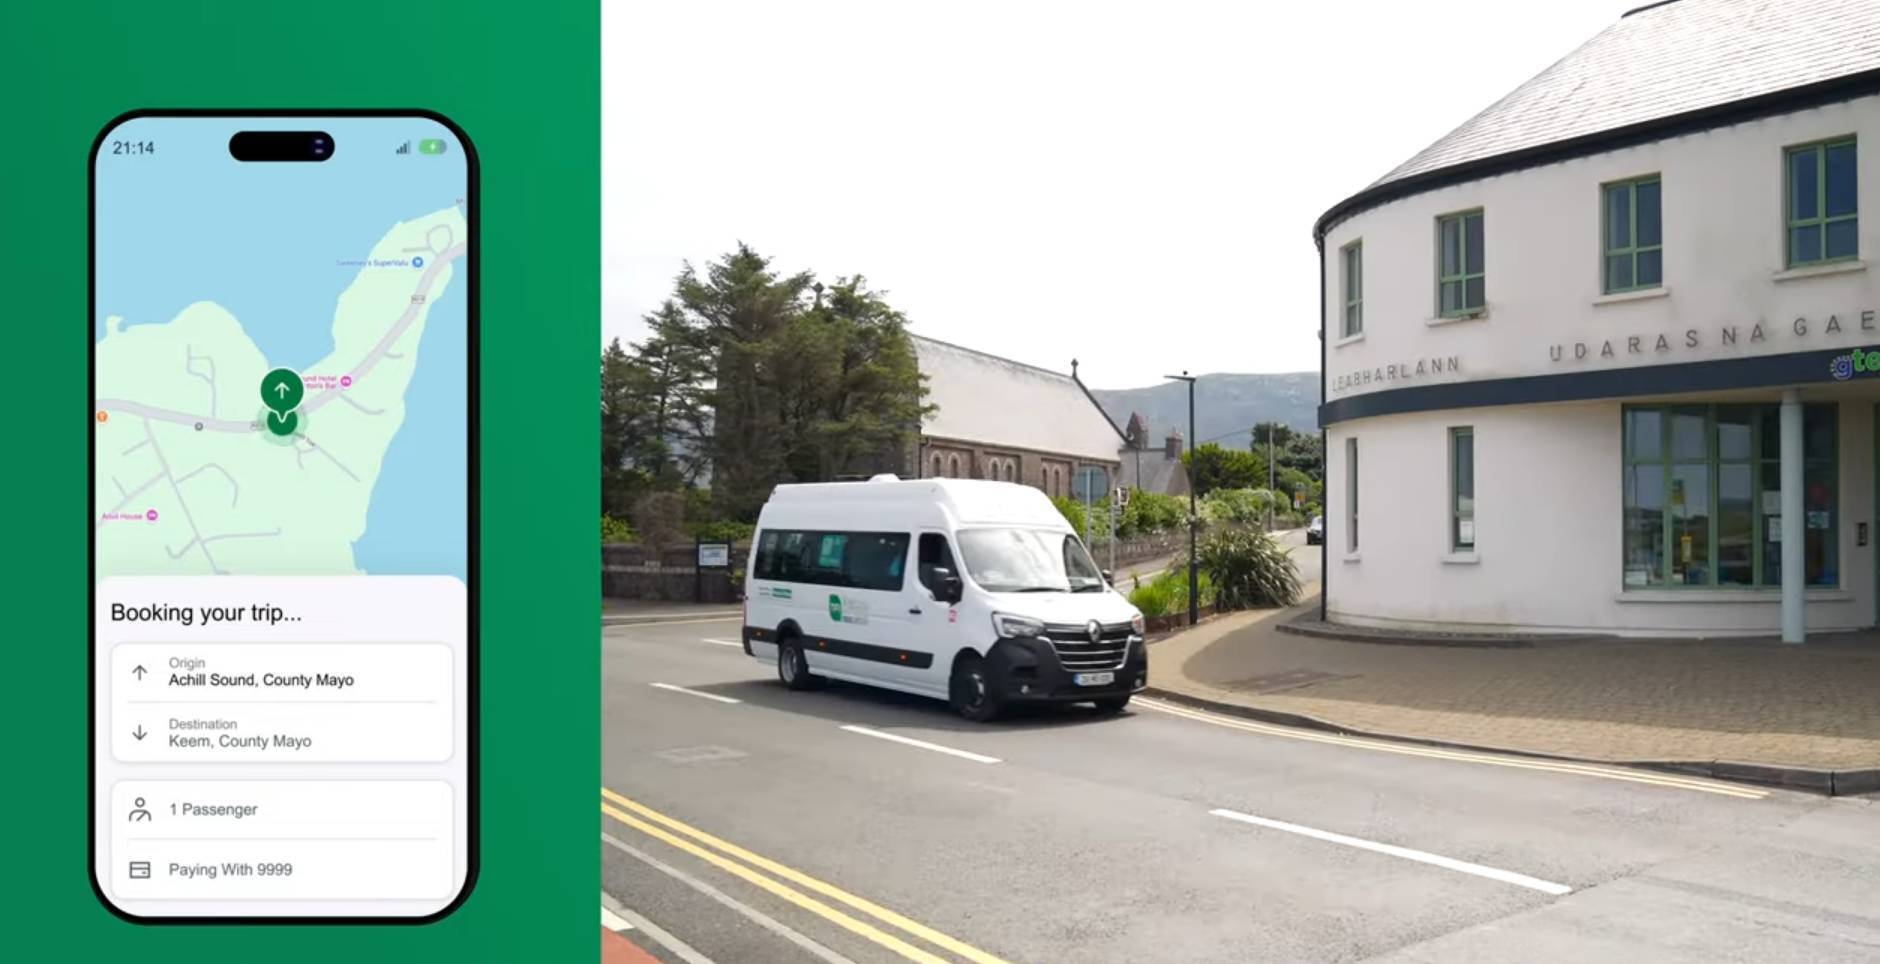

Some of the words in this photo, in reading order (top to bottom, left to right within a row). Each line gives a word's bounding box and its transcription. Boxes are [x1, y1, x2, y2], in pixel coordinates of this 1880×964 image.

[112, 140, 155, 155] 21:14
[1550, 329, 1699, 361] UDARAS
[1721, 323, 1766, 345] NA
[1793, 310, 1876, 336] GAE
[1332, 356, 1459, 392] LEABHARLANN
[110, 602, 194, 627] Booking
[199, 606, 247, 627] your
[250, 602, 302, 627] trip...
[168, 656, 206, 672] Origin
[168, 672, 207, 687] Achill
[209, 672, 259, 688] Sound,
[262, 672, 313, 690] County
[315, 672, 355, 690] Mayo
[168, 718, 238, 730] Destination
[168, 734, 215, 750] Keem,
[218, 733, 270, 751] County
[273, 733, 313, 751] Mayo
[170, 802, 177, 816] 1
[182, 802, 259, 820] Passenger
[168, 862, 218, 880] Paying
[221, 862, 254, 877] With
[256, 862, 293, 877] 9999
